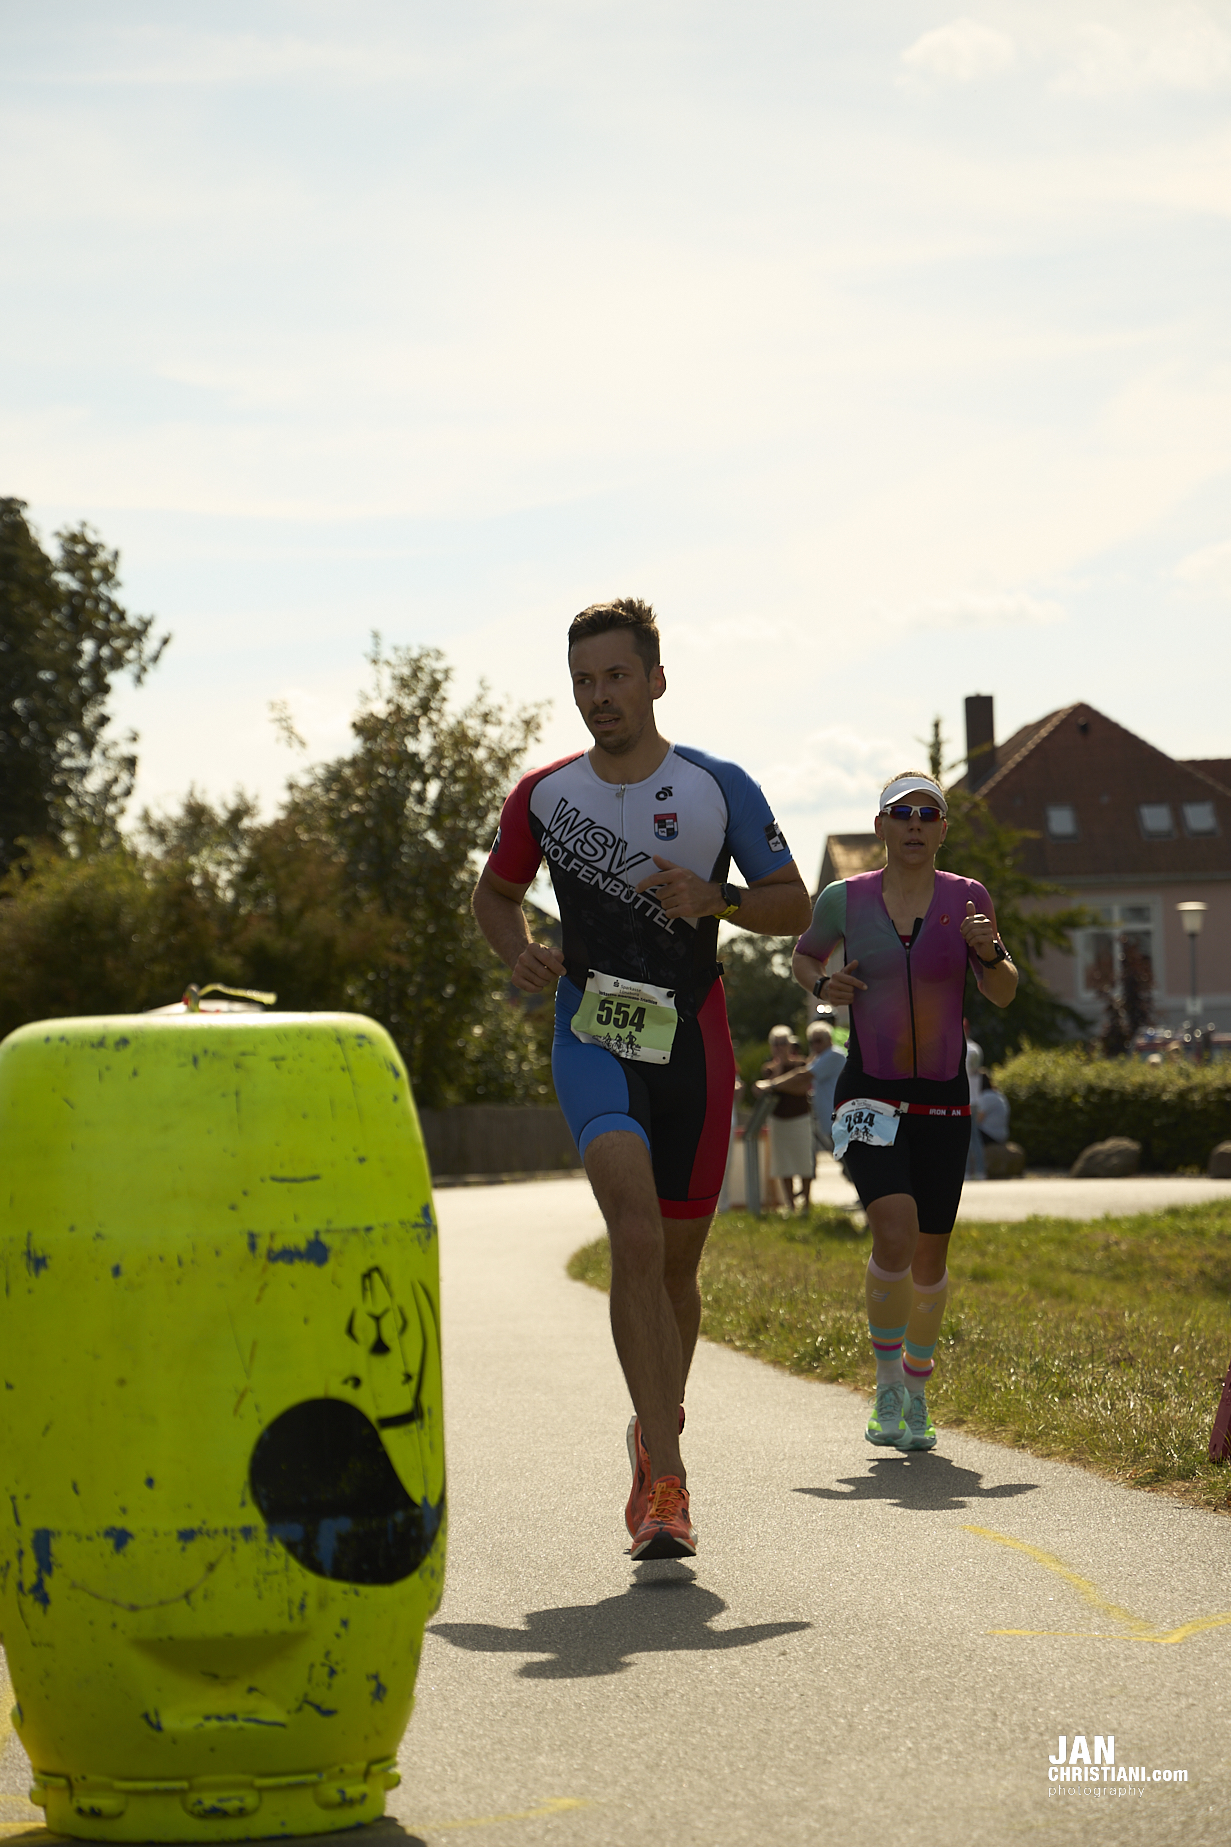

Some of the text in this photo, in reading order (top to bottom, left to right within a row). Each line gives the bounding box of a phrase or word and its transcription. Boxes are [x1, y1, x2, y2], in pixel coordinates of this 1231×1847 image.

[548, 797, 651, 876] WSV
[539, 831, 675, 935] WOLFENBÜTTEL
[596, 999, 646, 1033] 554
[620, 984, 642, 992] Sparkasse
